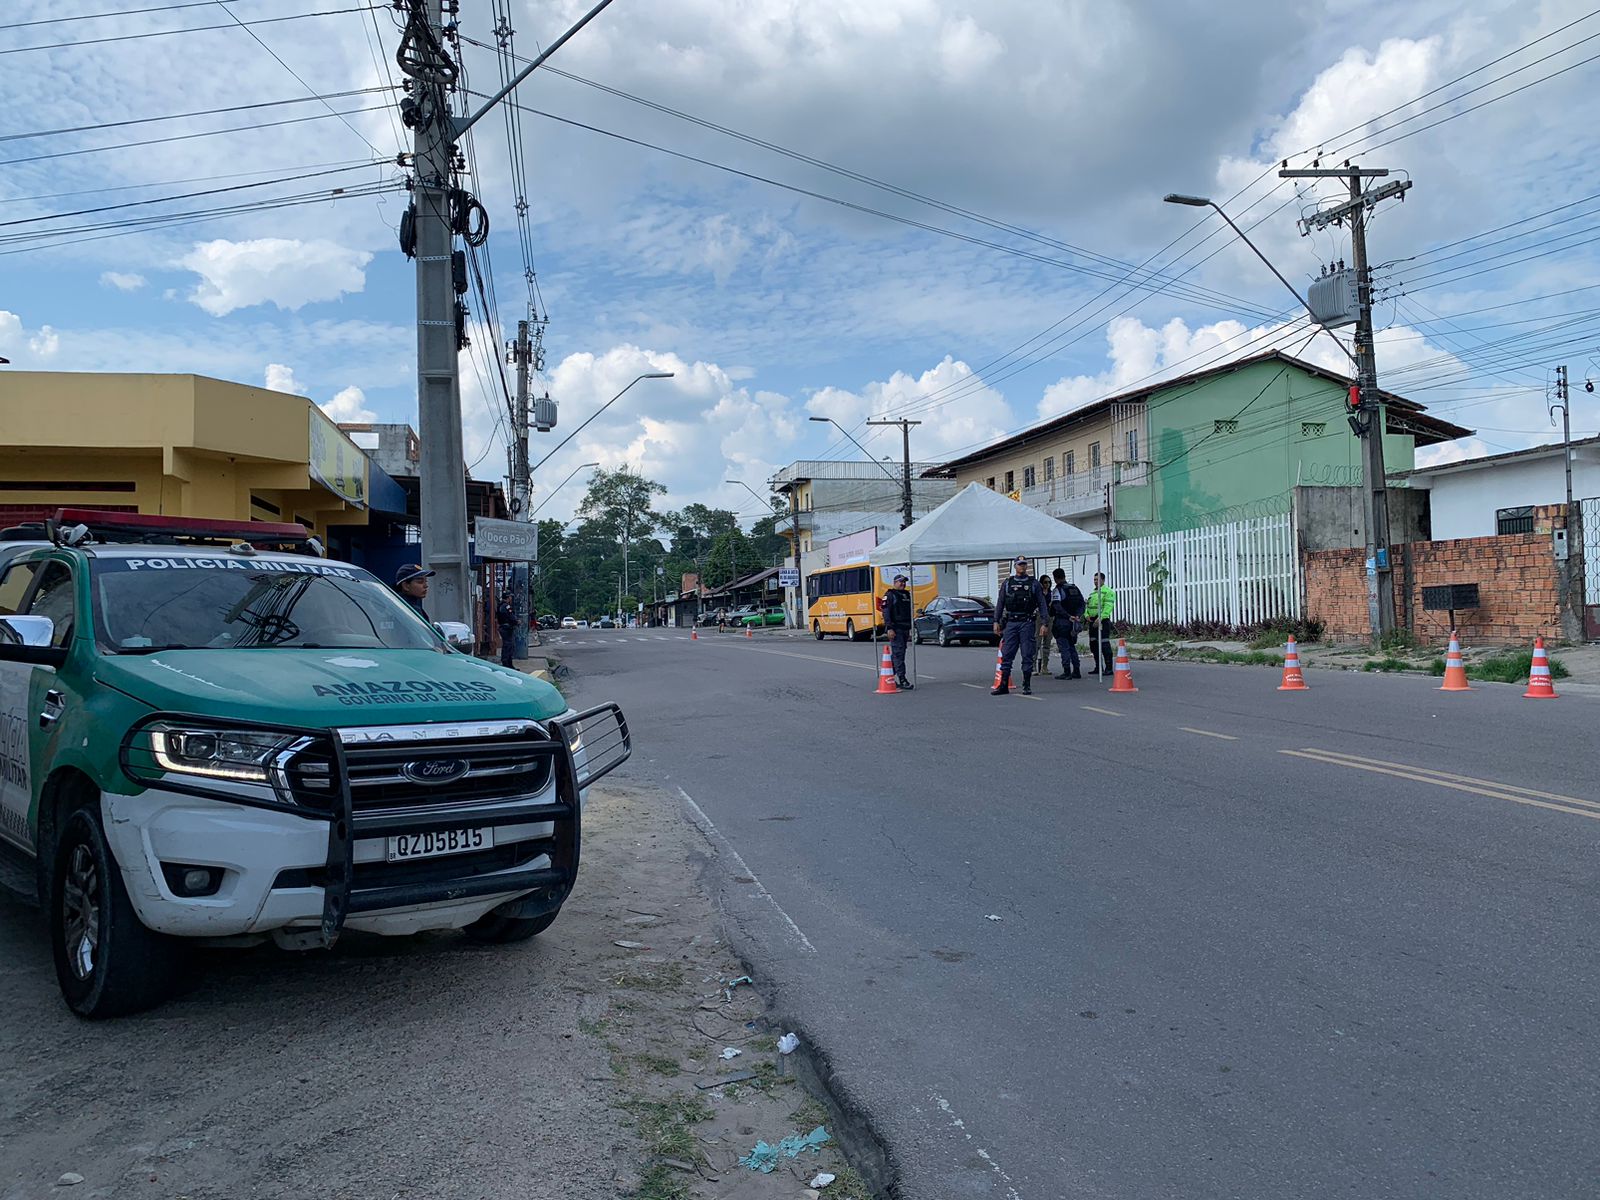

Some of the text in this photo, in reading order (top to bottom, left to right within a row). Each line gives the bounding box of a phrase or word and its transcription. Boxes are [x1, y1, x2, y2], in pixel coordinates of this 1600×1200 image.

[487, 531, 526, 545] Doce Pão
[125, 557, 354, 579] POLÍCIA MILITAR
[312, 680, 497, 697] AMAZONAS
[338, 692, 497, 706] GOVERNO DO ESTADO
[342, 725, 519, 743] RANGER
[422, 760, 455, 776] Ford
[397, 829, 483, 857] QZD5B15
